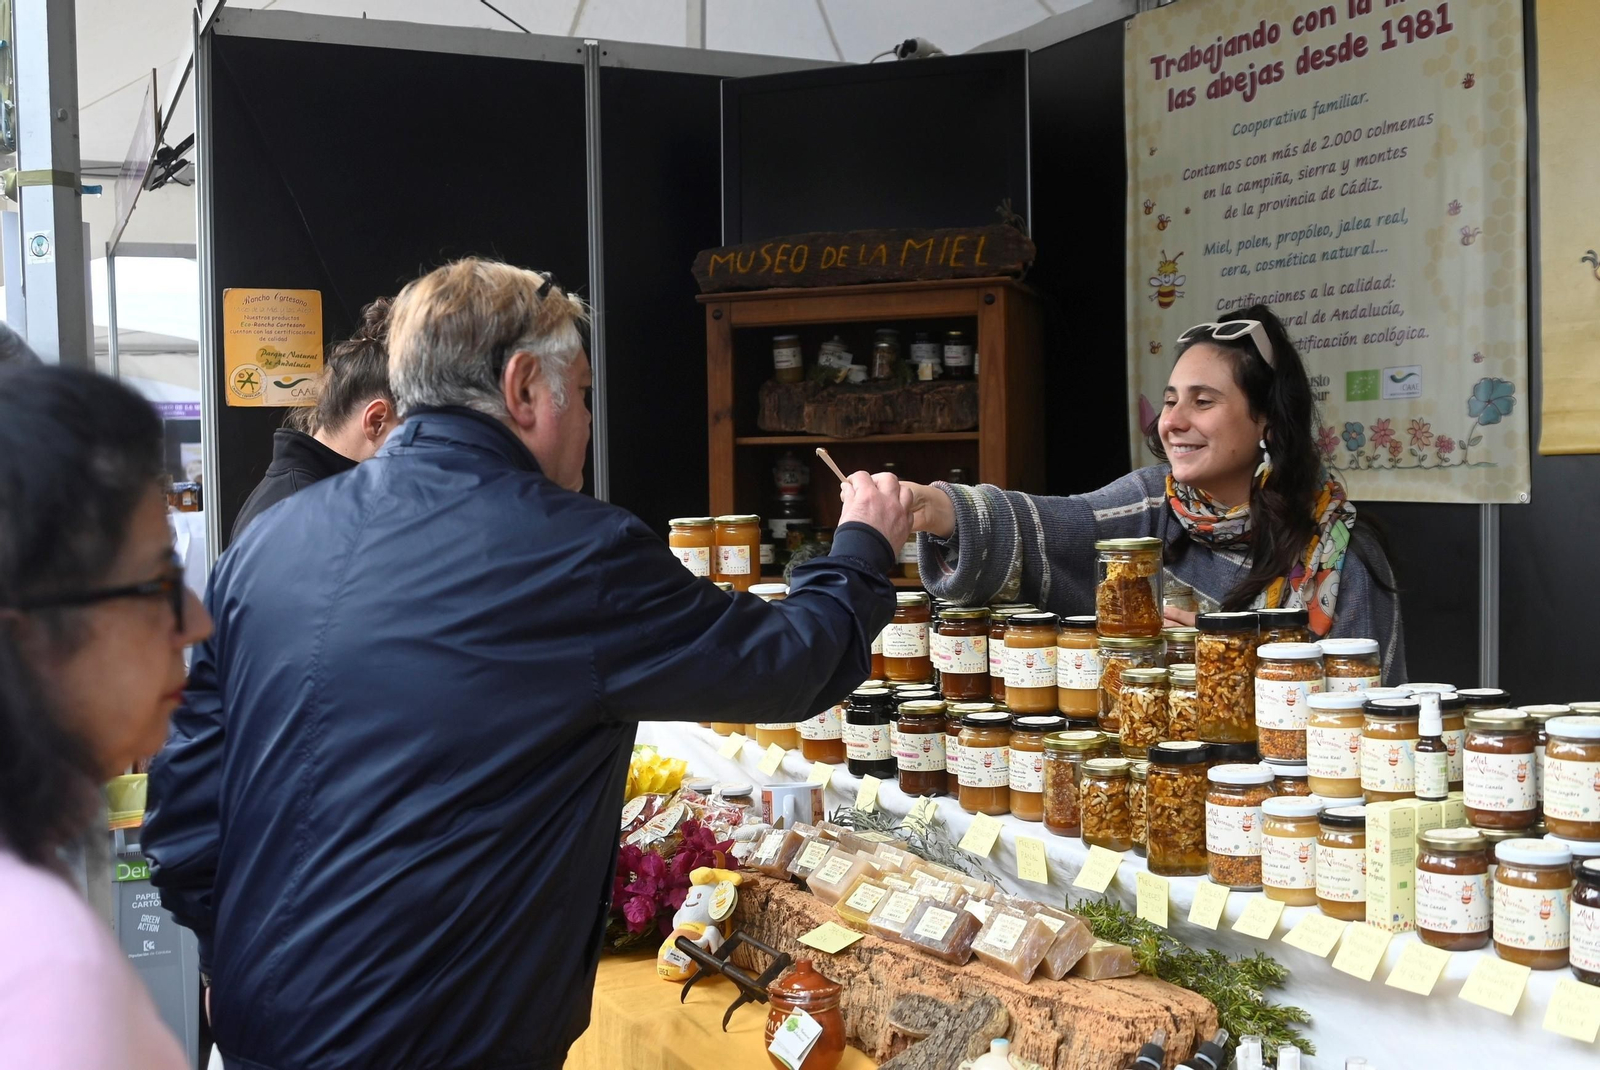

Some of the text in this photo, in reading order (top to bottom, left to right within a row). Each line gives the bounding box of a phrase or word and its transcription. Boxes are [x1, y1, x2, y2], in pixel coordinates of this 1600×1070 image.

[1150, 20, 1281, 81] Trabajando
[1292, 4, 1337, 36] con
[1168, 2, 1454, 112] las abejas desde 1981
[1232, 91, 1370, 138] Cooperativa familiar.
[1183, 112, 1435, 181] Contamos con más de 2.000 colmenas
[1203, 145, 1408, 200] en la campiña, sierra y montes
[1224, 177, 1383, 220] de la provincia de Cádiz.
[1203, 208, 1409, 257] Miel, polen, propóleo, jalea real,
[709, 235, 990, 278] MUSEO DE LA MIEL
[1221, 239, 1388, 278] cera, cosmética natural...
[242, 292, 308, 307] Rancho Cortesano
[1217, 273, 1397, 311] Certificaciones a la calidad:
[1278, 301, 1405, 328] ural de Andalucía,
[1294, 325, 1429, 353] tificación ecológica.
[1308, 374, 1331, 387] usto
[1470, 754, 1488, 766] Miel
[136, 892, 160, 901] PAPEL
[1577, 908, 1596, 922] Miel
[138, 922, 160, 932] ACTION
[140, 914, 160, 924] GREEN
